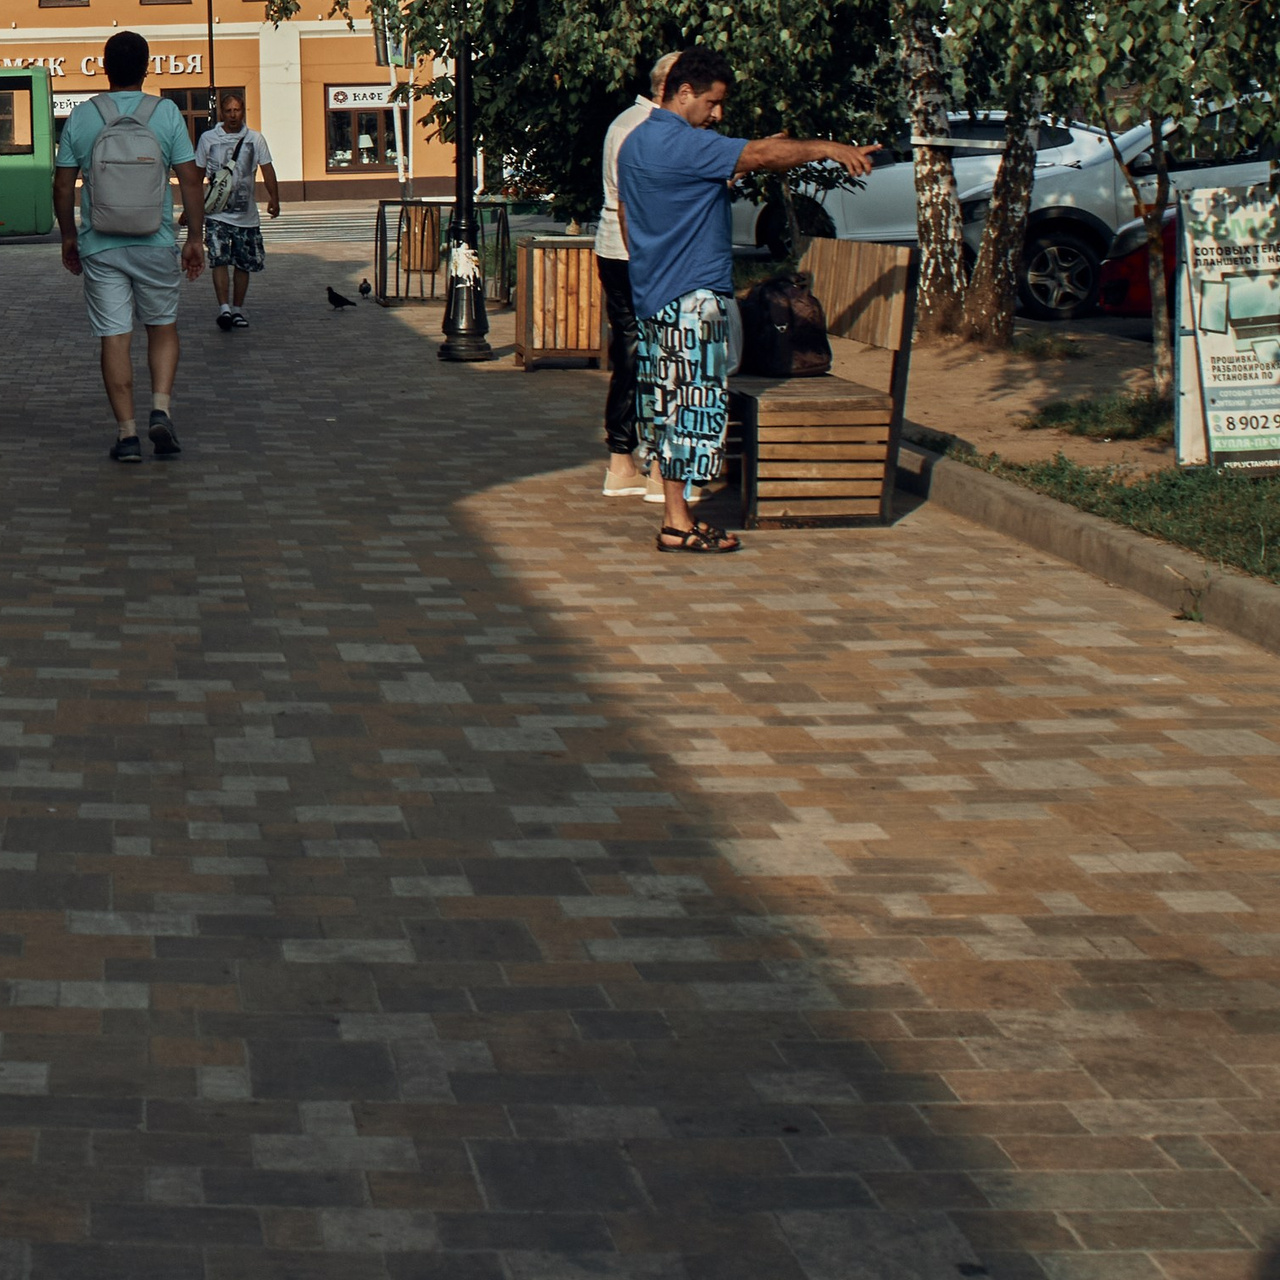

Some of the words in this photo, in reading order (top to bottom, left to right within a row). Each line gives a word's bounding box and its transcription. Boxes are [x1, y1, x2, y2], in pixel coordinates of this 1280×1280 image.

[81, 54, 203, 76] СТЬЯ
[353, 93, 383, 102] КАФЕ
[1194, 245, 1250, 256] СОТОВЫХ
[1194, 257, 1259, 267] ПЛАНШЕТОВ
[1211, 355, 1257, 364] ПРОШИВКА
[1212, 372, 1259, 381] УСТАНОВКА
[1262, 371, 1273, 380] ПО
[1226, 416, 1236, 431] 8
[1239, 415, 1270, 430] 902
